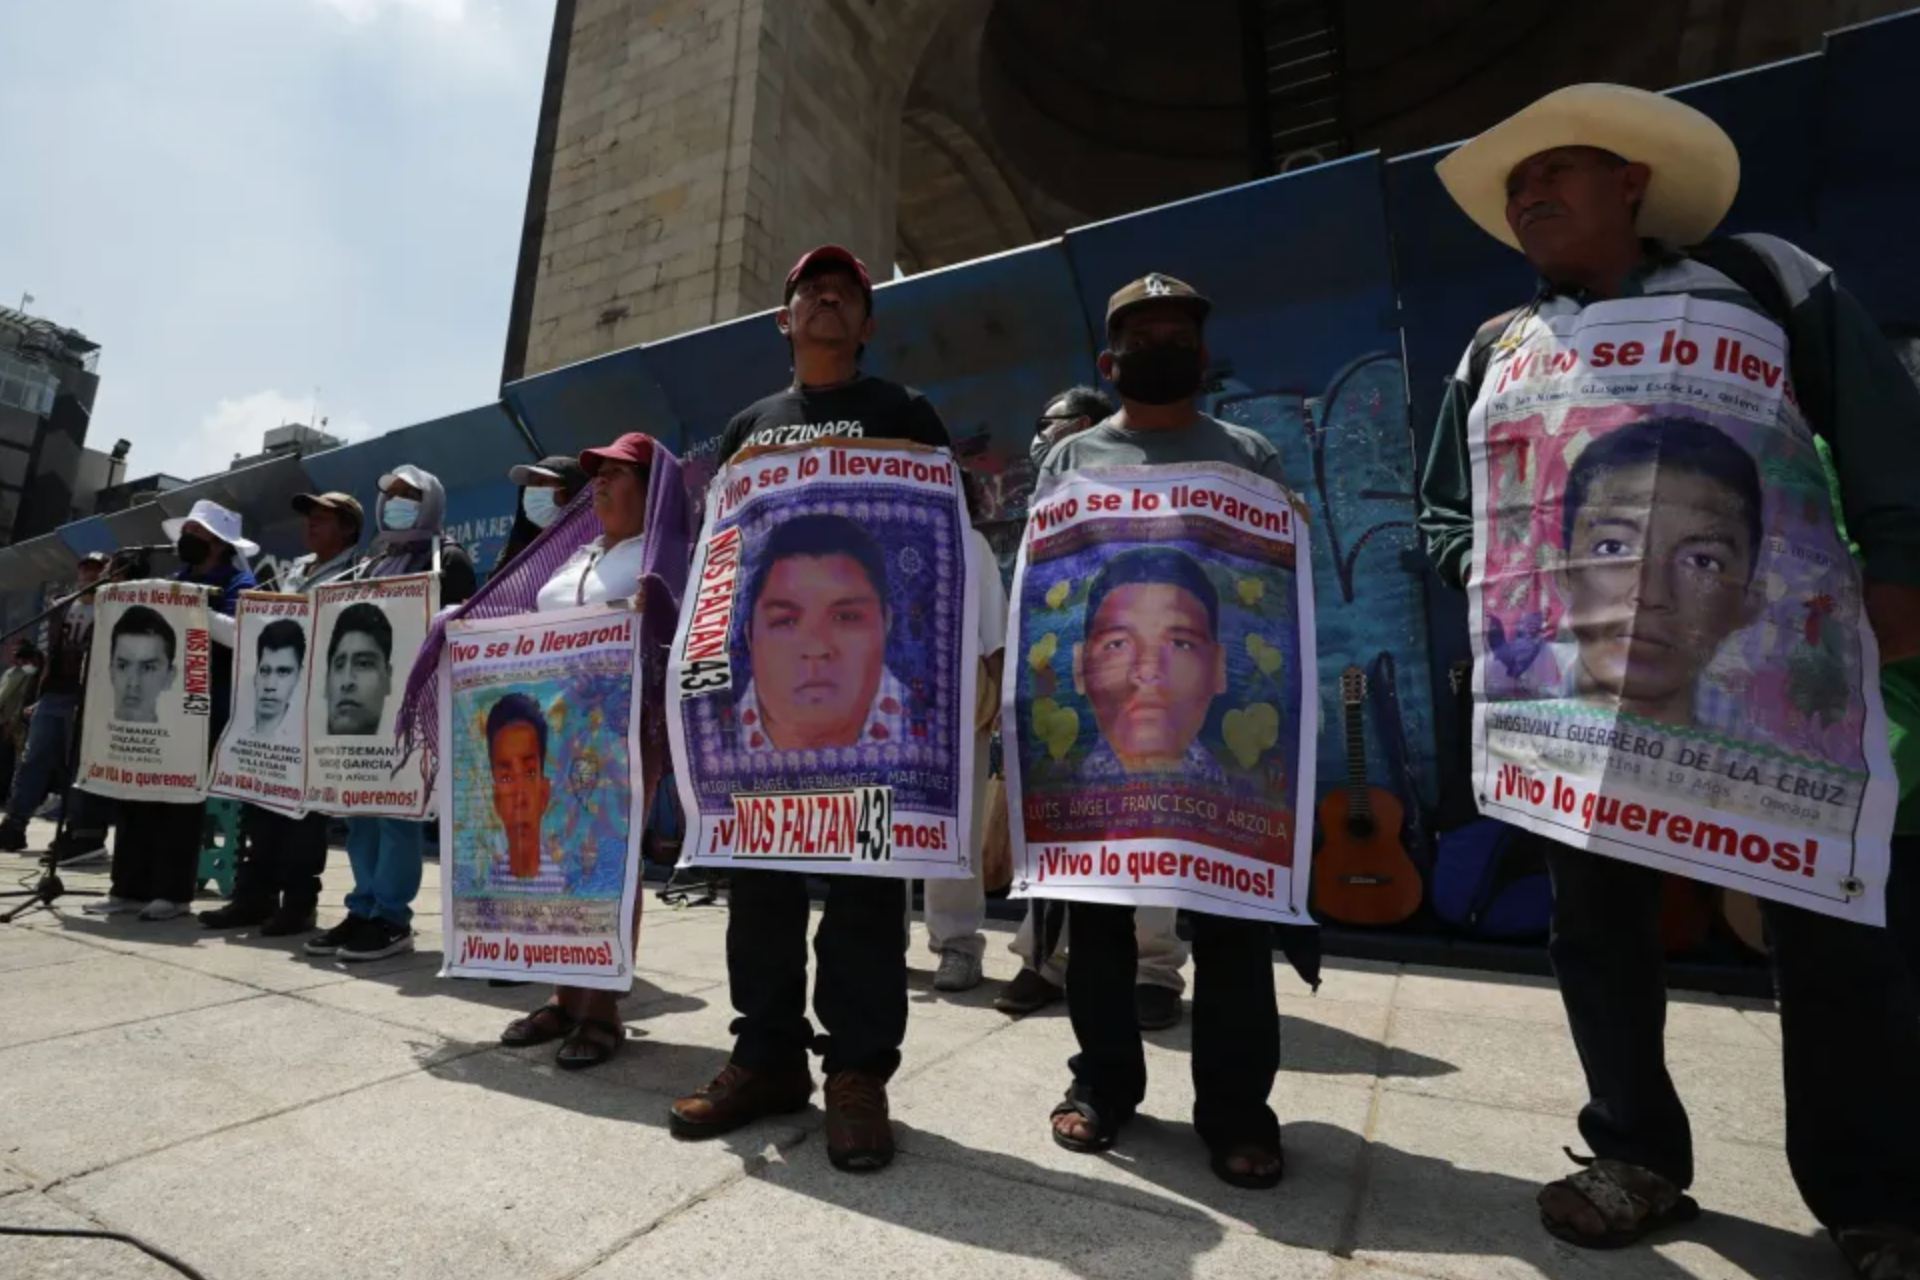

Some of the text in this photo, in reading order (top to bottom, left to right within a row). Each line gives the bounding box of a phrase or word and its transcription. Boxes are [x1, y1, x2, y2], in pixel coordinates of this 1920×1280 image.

[1590, 340, 1645, 368] se
[1658, 329, 1698, 366] lo
[758, 465, 789, 488] se
[797, 456, 819, 480] lo
[829, 449, 953, 486] llevaron!
[1086, 492, 1122, 512] se
[1131, 488, 1160, 511] lo
[1171, 485, 1290, 535] llevaron!
[703, 528, 738, 581] NOS
[484, 641, 509, 658] se
[513, 636, 535, 656] lo
[540, 620, 632, 653] llevaron!
[686, 580, 735, 662] FALTAN
[1567, 723, 1665, 760] GUERRERO
[1678, 747, 1710, 770] DE
[1727, 761, 1762, 787] LA
[1777, 774, 1846, 806] CRUZ
[341, 789, 419, 808] queremos!
[734, 786, 892, 861] NOS FALTAN 43!
[1121, 794, 1217, 819] FRANCISCO
[1226, 809, 1288, 841] ARZOLA
[1495, 763, 1818, 877] ¡Vivo lo queremos!
[1038, 845, 1275, 899] ¡Vivo lo queremos!
[460, 934, 613, 969] ¡Vivo lo queremos!
